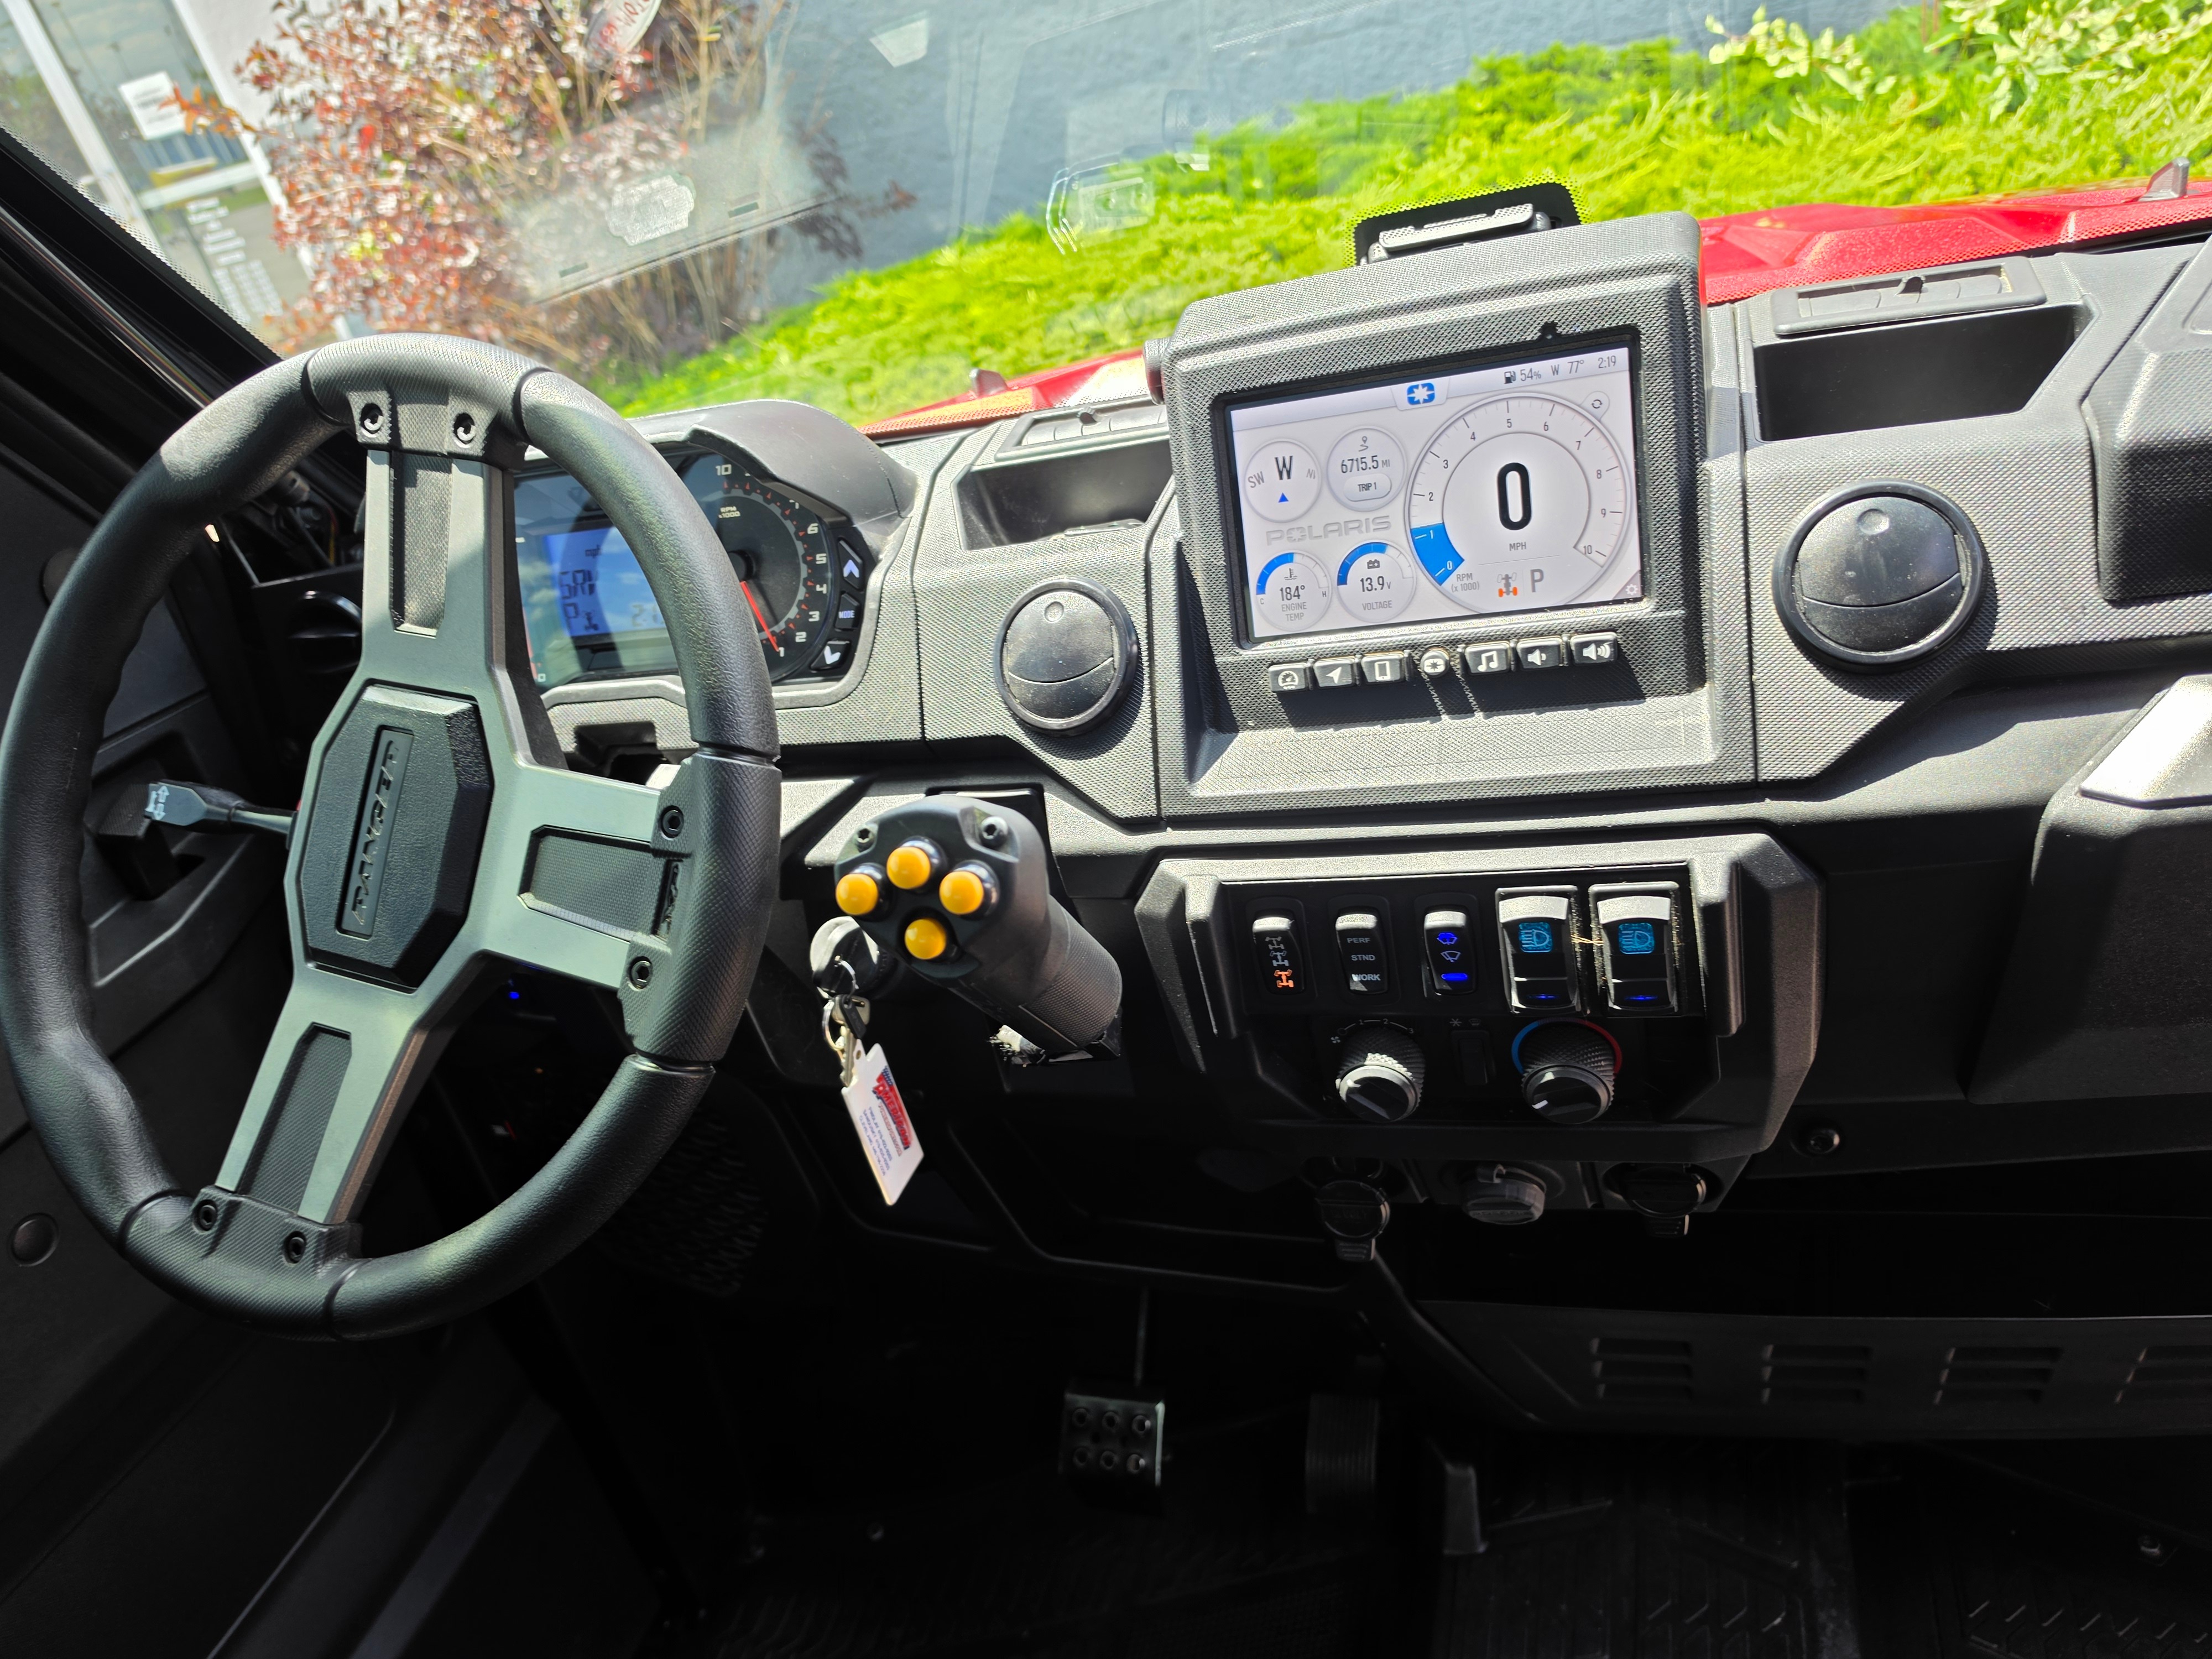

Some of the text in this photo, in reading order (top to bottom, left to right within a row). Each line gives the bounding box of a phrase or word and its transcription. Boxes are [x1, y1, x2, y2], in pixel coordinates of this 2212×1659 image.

[1520, 355, 1617, 382] 54% W 77° 2:19
[1506, 419, 1512, 428] 5
[1543, 421, 1549, 431] 6
[1470, 431, 1476, 441] 4
[1575, 440, 1582, 451] 7
[1274, 455, 1293, 480] W
[1340, 455, 1390, 474] 6715.5 MI
[1443, 460, 1449, 469] 3
[716, 464, 732, 476] 10
[1597, 469, 1602, 479] 8
[1248, 471, 1265, 488] SW
[1358, 483, 1373, 492] TRIP
[1428, 492, 1434, 502] 2
[1497, 462, 1532, 531] 0
[1601, 508, 1606, 518] 9
[807, 523, 818, 534] 6
[1266, 515, 1392, 546] POLARIS
[1430, 530, 1434, 539] 1
[1509, 542, 1527, 551] MPH
[1583, 545, 1593, 555] 10
[815, 553, 827, 564] 5
[1447, 561, 1453, 570] 0
[1456, 573, 1473, 582] RPM
[1530, 568, 1544, 593] P
[816, 584, 827, 594] 4
[1360, 576, 1385, 592] 13.9
[1460, 582, 1480, 592] 1000)
[1279, 585, 1306, 601] 184°
[1281, 602, 1307, 612] ENGINE
[1362, 600, 1392, 611] VOLTAGE
[808, 611, 820, 622] 3
[838, 610, 855, 619] MODE
[1285, 612, 1304, 622] TEMP
[795, 632, 807, 642] 2
[352, 740, 398, 926] RANGER
